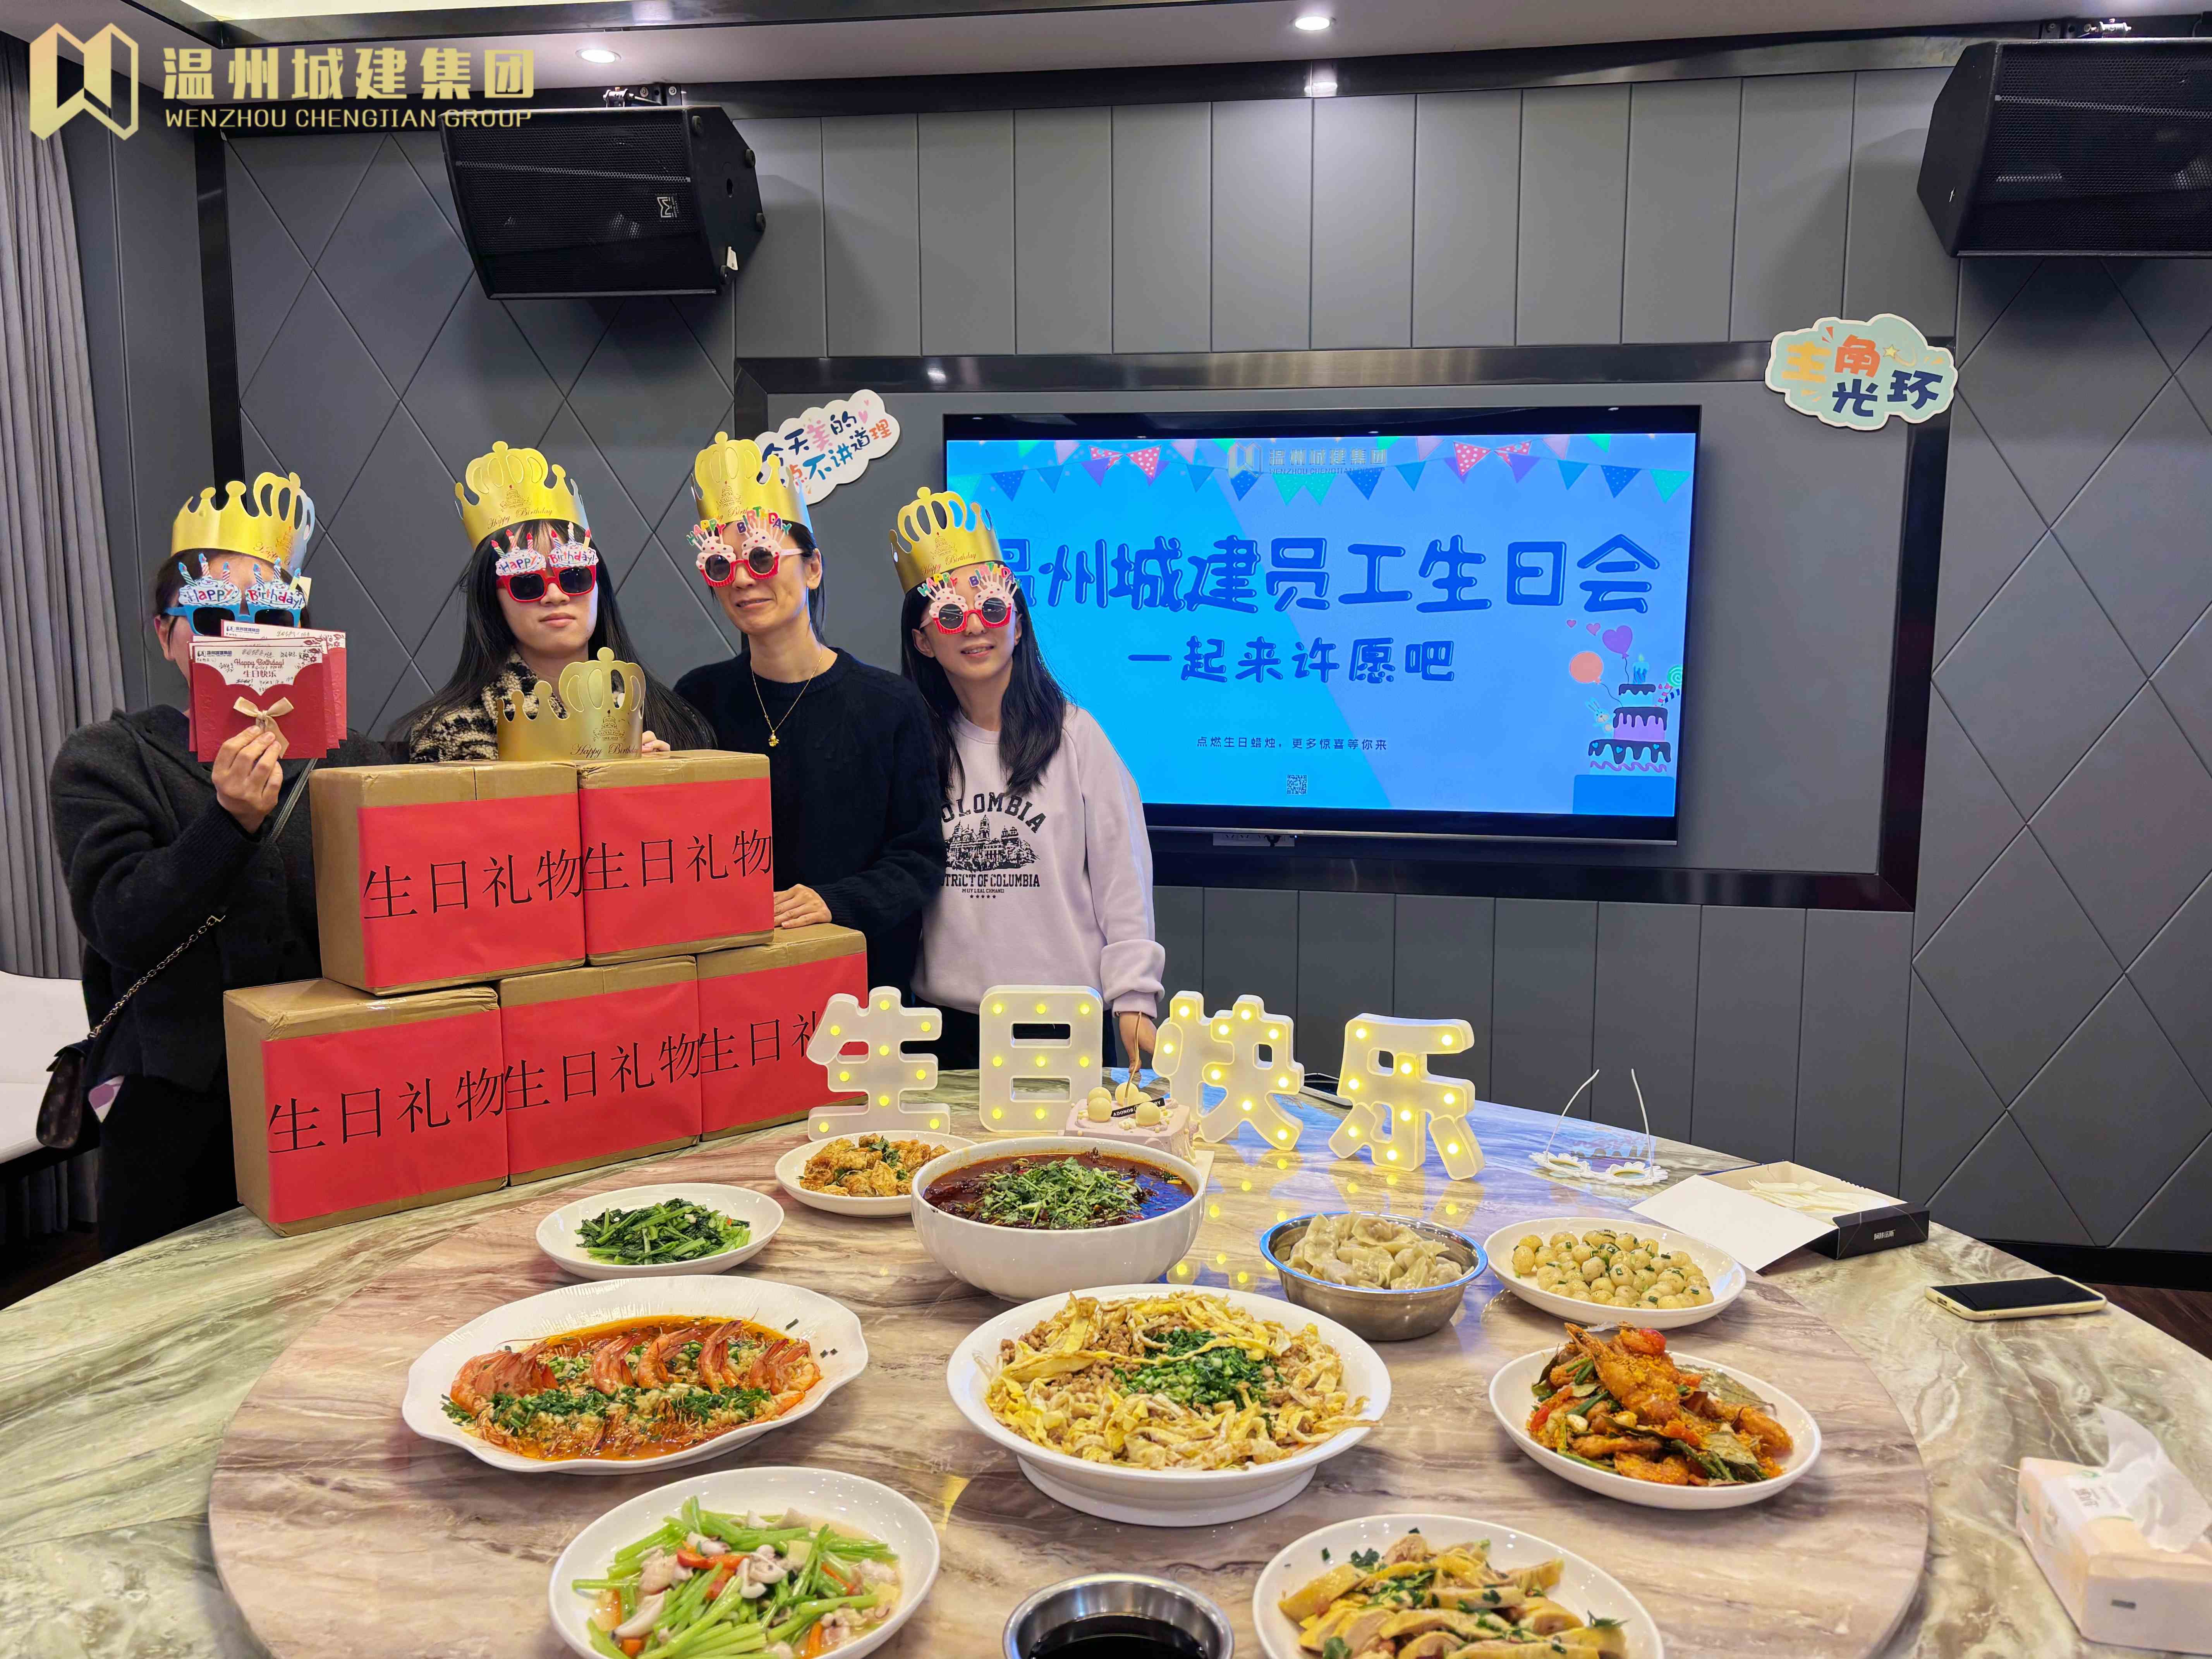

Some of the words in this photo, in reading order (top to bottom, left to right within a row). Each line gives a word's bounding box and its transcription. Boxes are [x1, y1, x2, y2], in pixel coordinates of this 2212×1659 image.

[1781, 334, 1881, 383] 主角
[1832, 369, 1943, 417] 光环
[756, 419, 892, 487] 点不讲道理
[1269, 448, 1387, 465] 温州城建集团
[488, 514, 510, 529] Happy
[515, 507, 553, 518] Birthday
[917, 572, 958, 597] HAPPY
[969, 561, 1022, 589] BIRTHDAY
[945, 552, 976, 565] Birthday
[234, 659, 256, 668] Happy
[1128, 635, 1455, 684] 一起来许愿吧
[570, 743, 602, 759] Happy
[583, 828, 772, 891] 生日礼物
[978, 874, 989, 887] OF
[990, 874, 1040, 887] COLUMBIA
[363, 848, 584, 921] 生日礼物
[699, 1010, 816, 1075] 生日礼
[504, 1032, 700, 1111] 生日礼物
[807, 985, 1485, 1181] 生日快乐
[268, 1067, 505, 1154] 生日礼物
